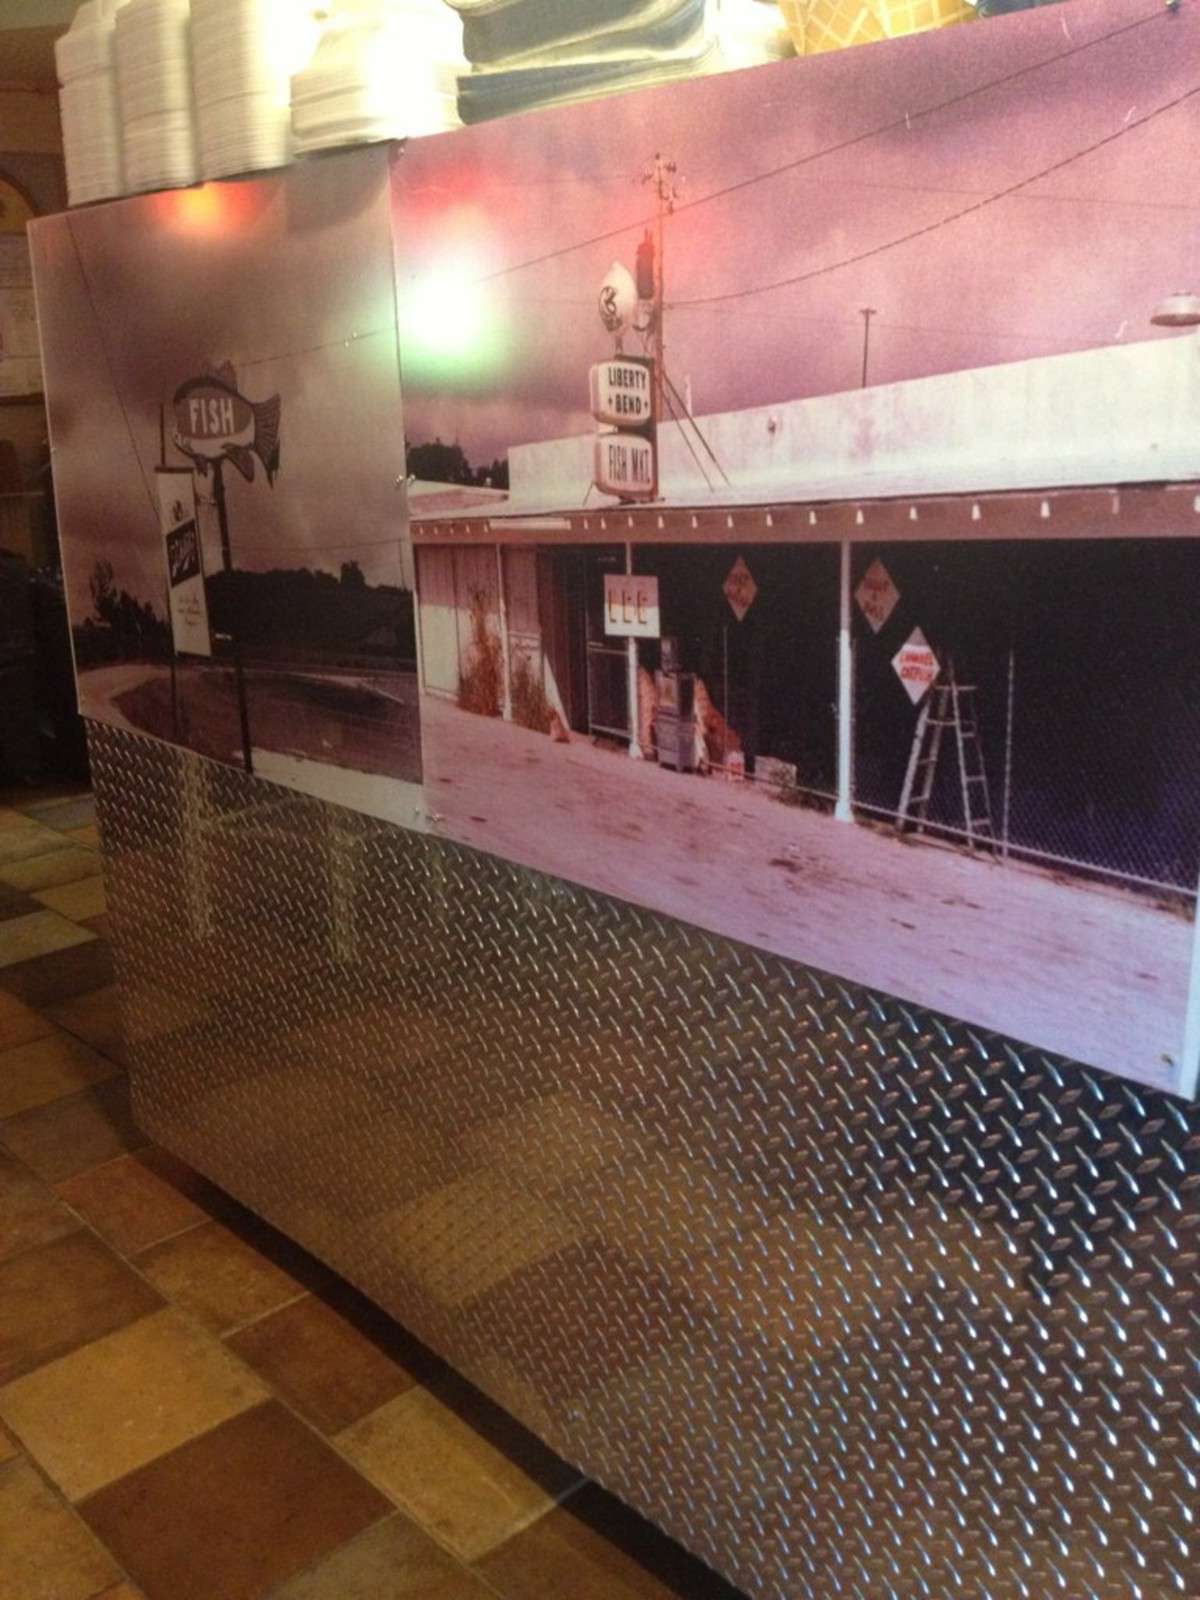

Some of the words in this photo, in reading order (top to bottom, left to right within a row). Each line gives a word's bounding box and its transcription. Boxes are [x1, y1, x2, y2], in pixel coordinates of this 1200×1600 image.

[608, 367, 646, 389] LIBERTY
[189, 398, 235, 434] FISH
[616, 394, 641, 414] BEND
[608, 444, 627, 481] FISH
